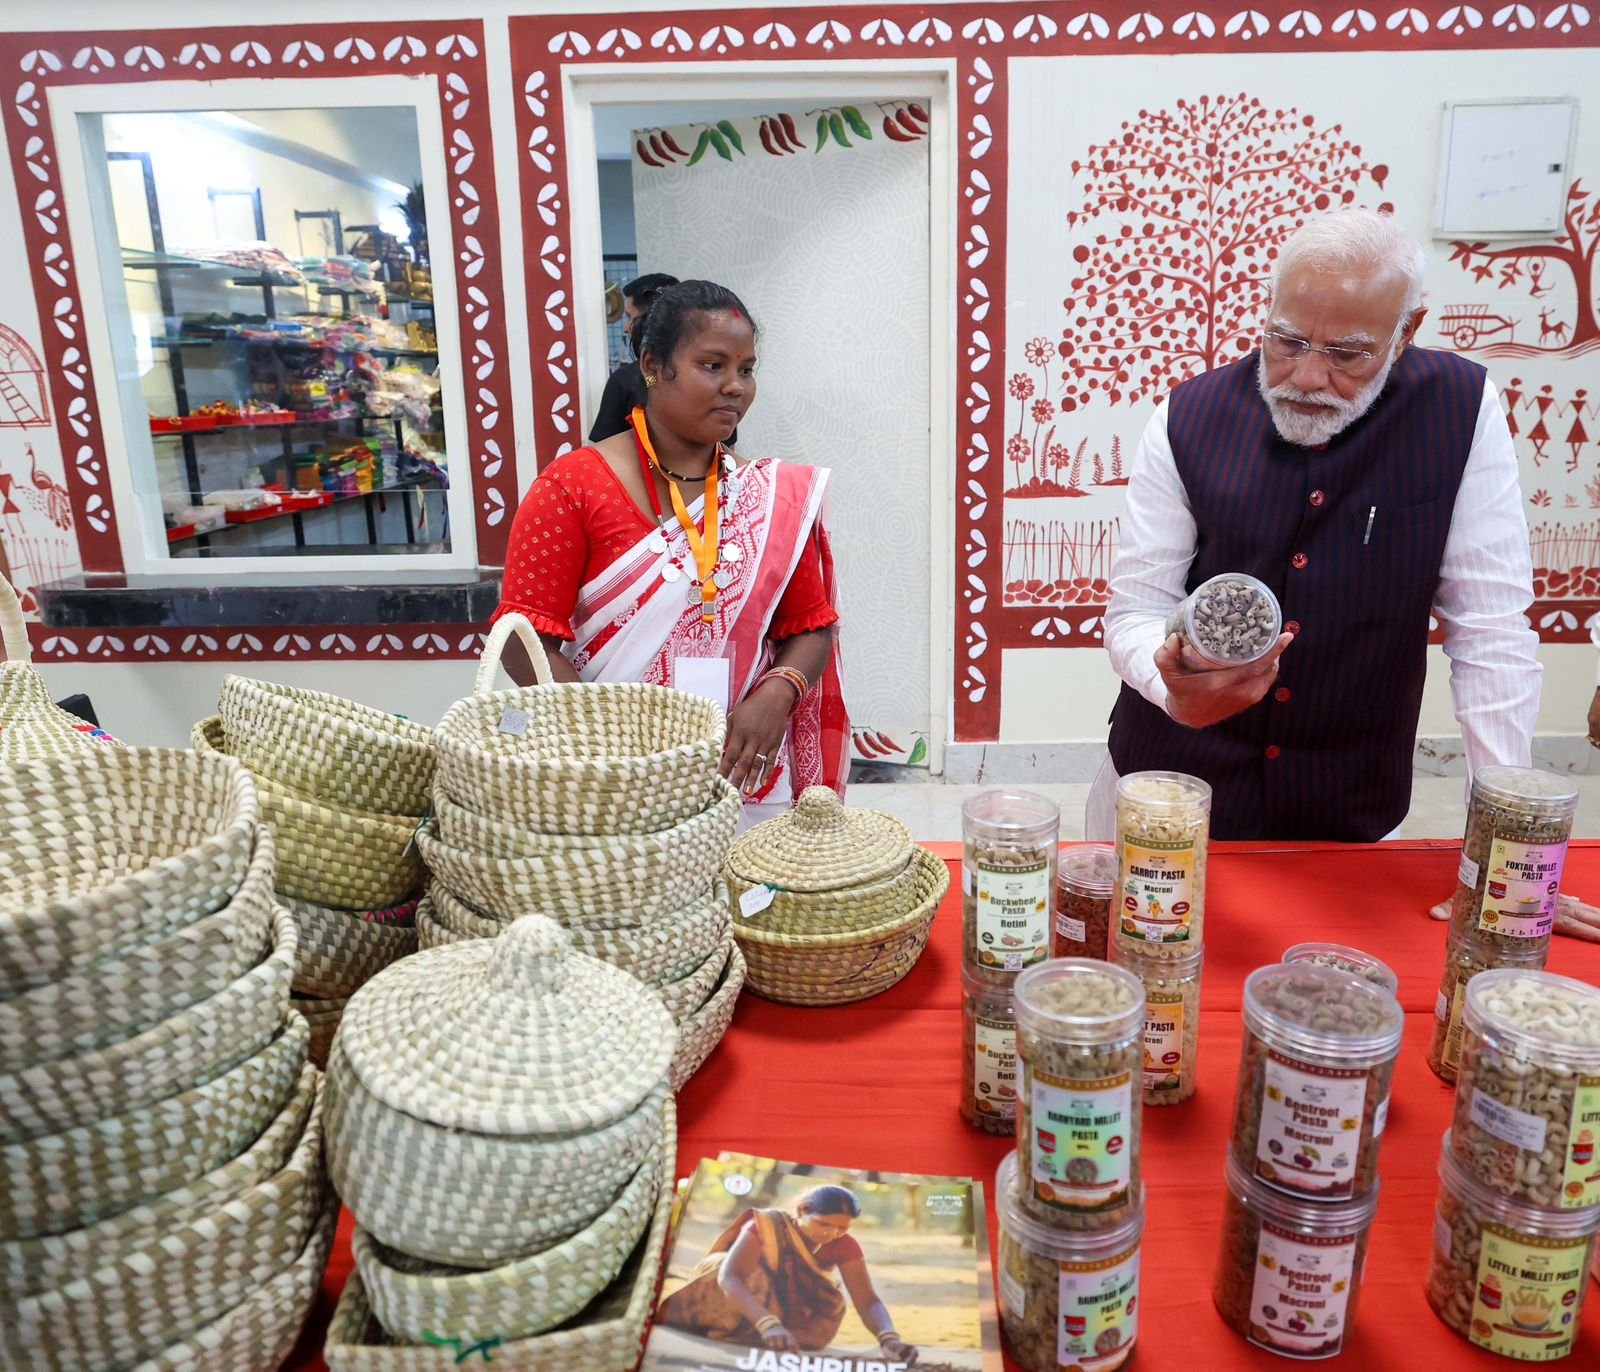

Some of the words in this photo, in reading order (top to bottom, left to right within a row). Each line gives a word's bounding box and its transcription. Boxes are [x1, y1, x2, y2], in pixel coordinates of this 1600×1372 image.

[1506, 860, 1535, 873] FOXTAIL
[1537, 863, 1557, 872] MILLET
[1130, 865, 1158, 880] CARROT
[1161, 870, 1185, 880] PASTA
[1521, 872, 1543, 880] PASTA
[1144, 885, 1173, 894] Macroni
[990, 896, 1036, 906] Buckwheat
[1002, 906, 1026, 914] Pasta
[1001, 920, 1027, 928] Rotini
[1151, 1022, 1175, 1032] PASTA
[1144, 1037, 1162, 1045] croni
[988, 1050, 1015, 1060] Buckw
[1284, 1096, 1340, 1118] Beetroot
[1292, 1111, 1328, 1128] Pasta
[1582, 1112, 1600, 1123] LITT
[1072, 1131, 1098, 1141] PASTA
[1284, 1126, 1334, 1146] Macroni
[1279, 1265, 1332, 1283] Beetroot
[1487, 1257, 1517, 1277] LITTLE
[1520, 1270, 1553, 1282] MILLET
[1557, 1269, 1579, 1281] PASTA
[1288, 1280, 1322, 1293] Pasta
[1278, 1293, 1326, 1309] Macroni
